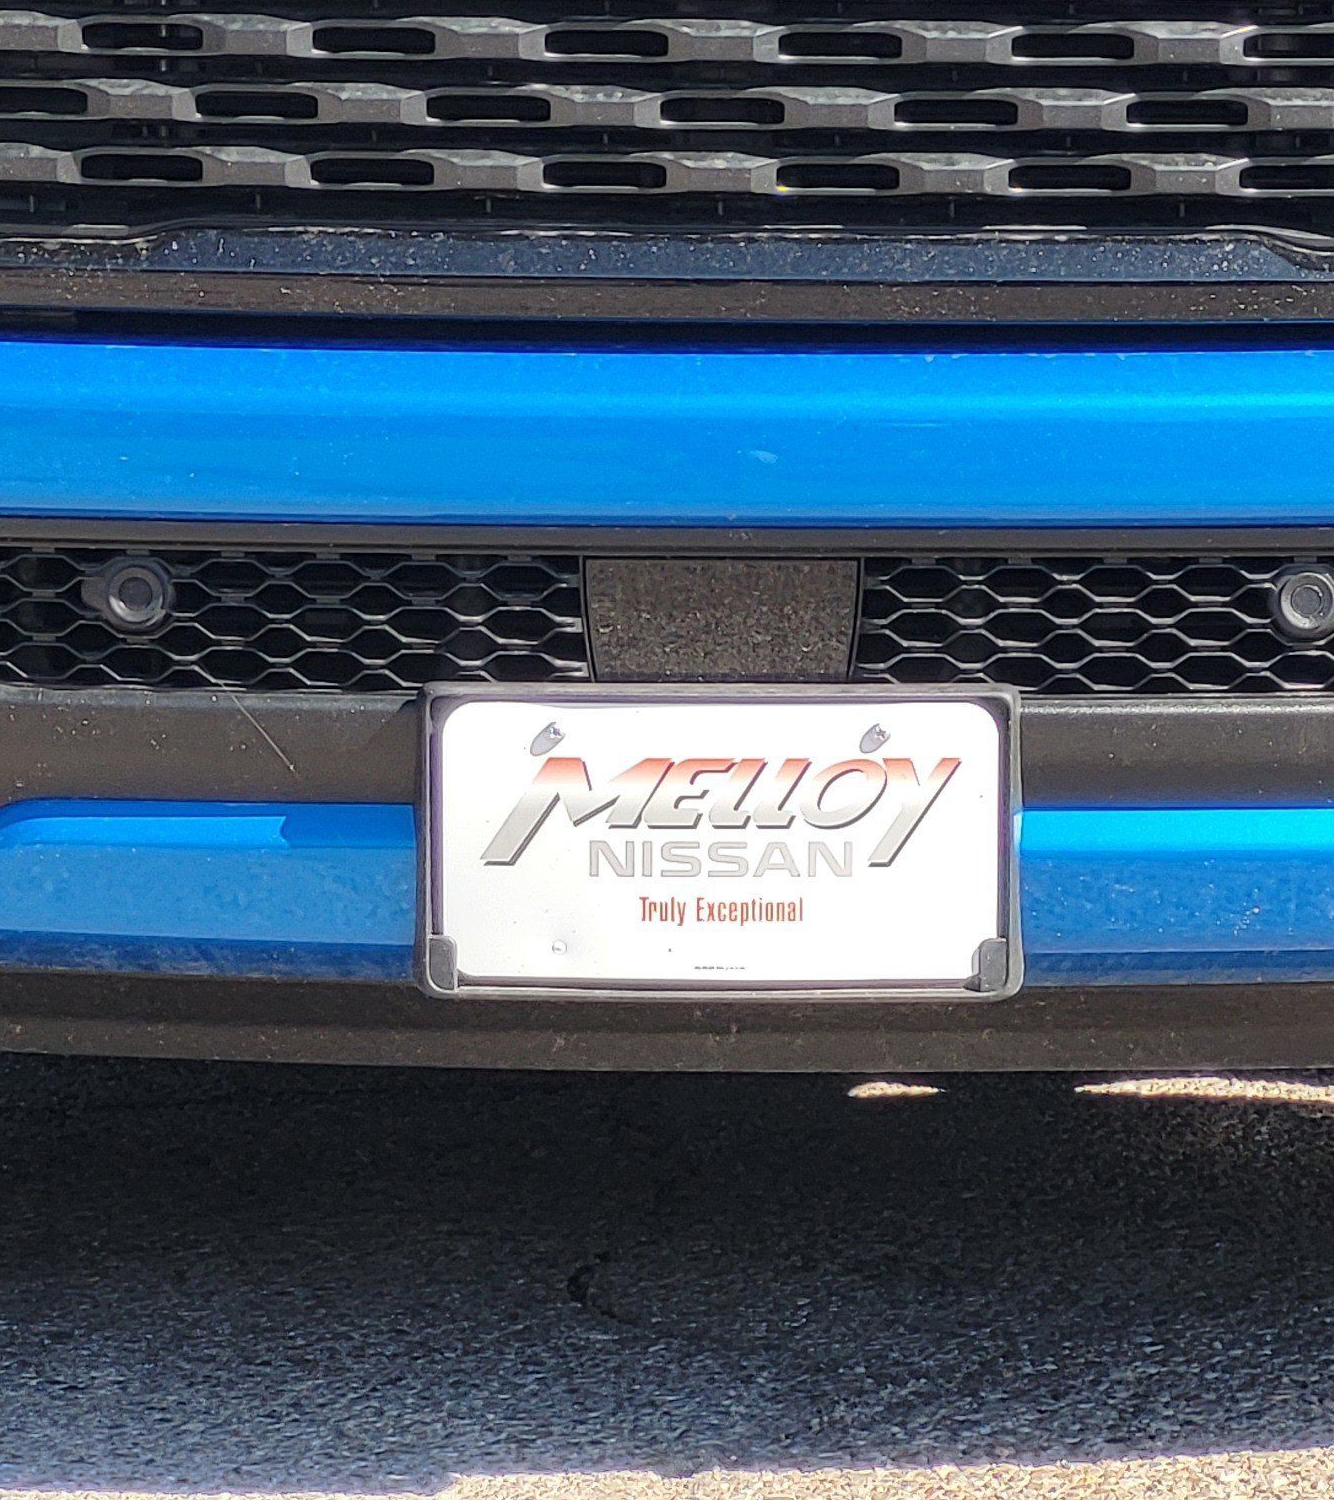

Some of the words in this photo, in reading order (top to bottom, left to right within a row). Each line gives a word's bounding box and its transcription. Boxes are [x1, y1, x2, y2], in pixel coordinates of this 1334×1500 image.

[480, 757, 962, 869] MELLOY
[588, 840, 854, 878] NISSAN
[638, 896, 687, 927] Truly
[696, 896, 805, 927] Exceptional
